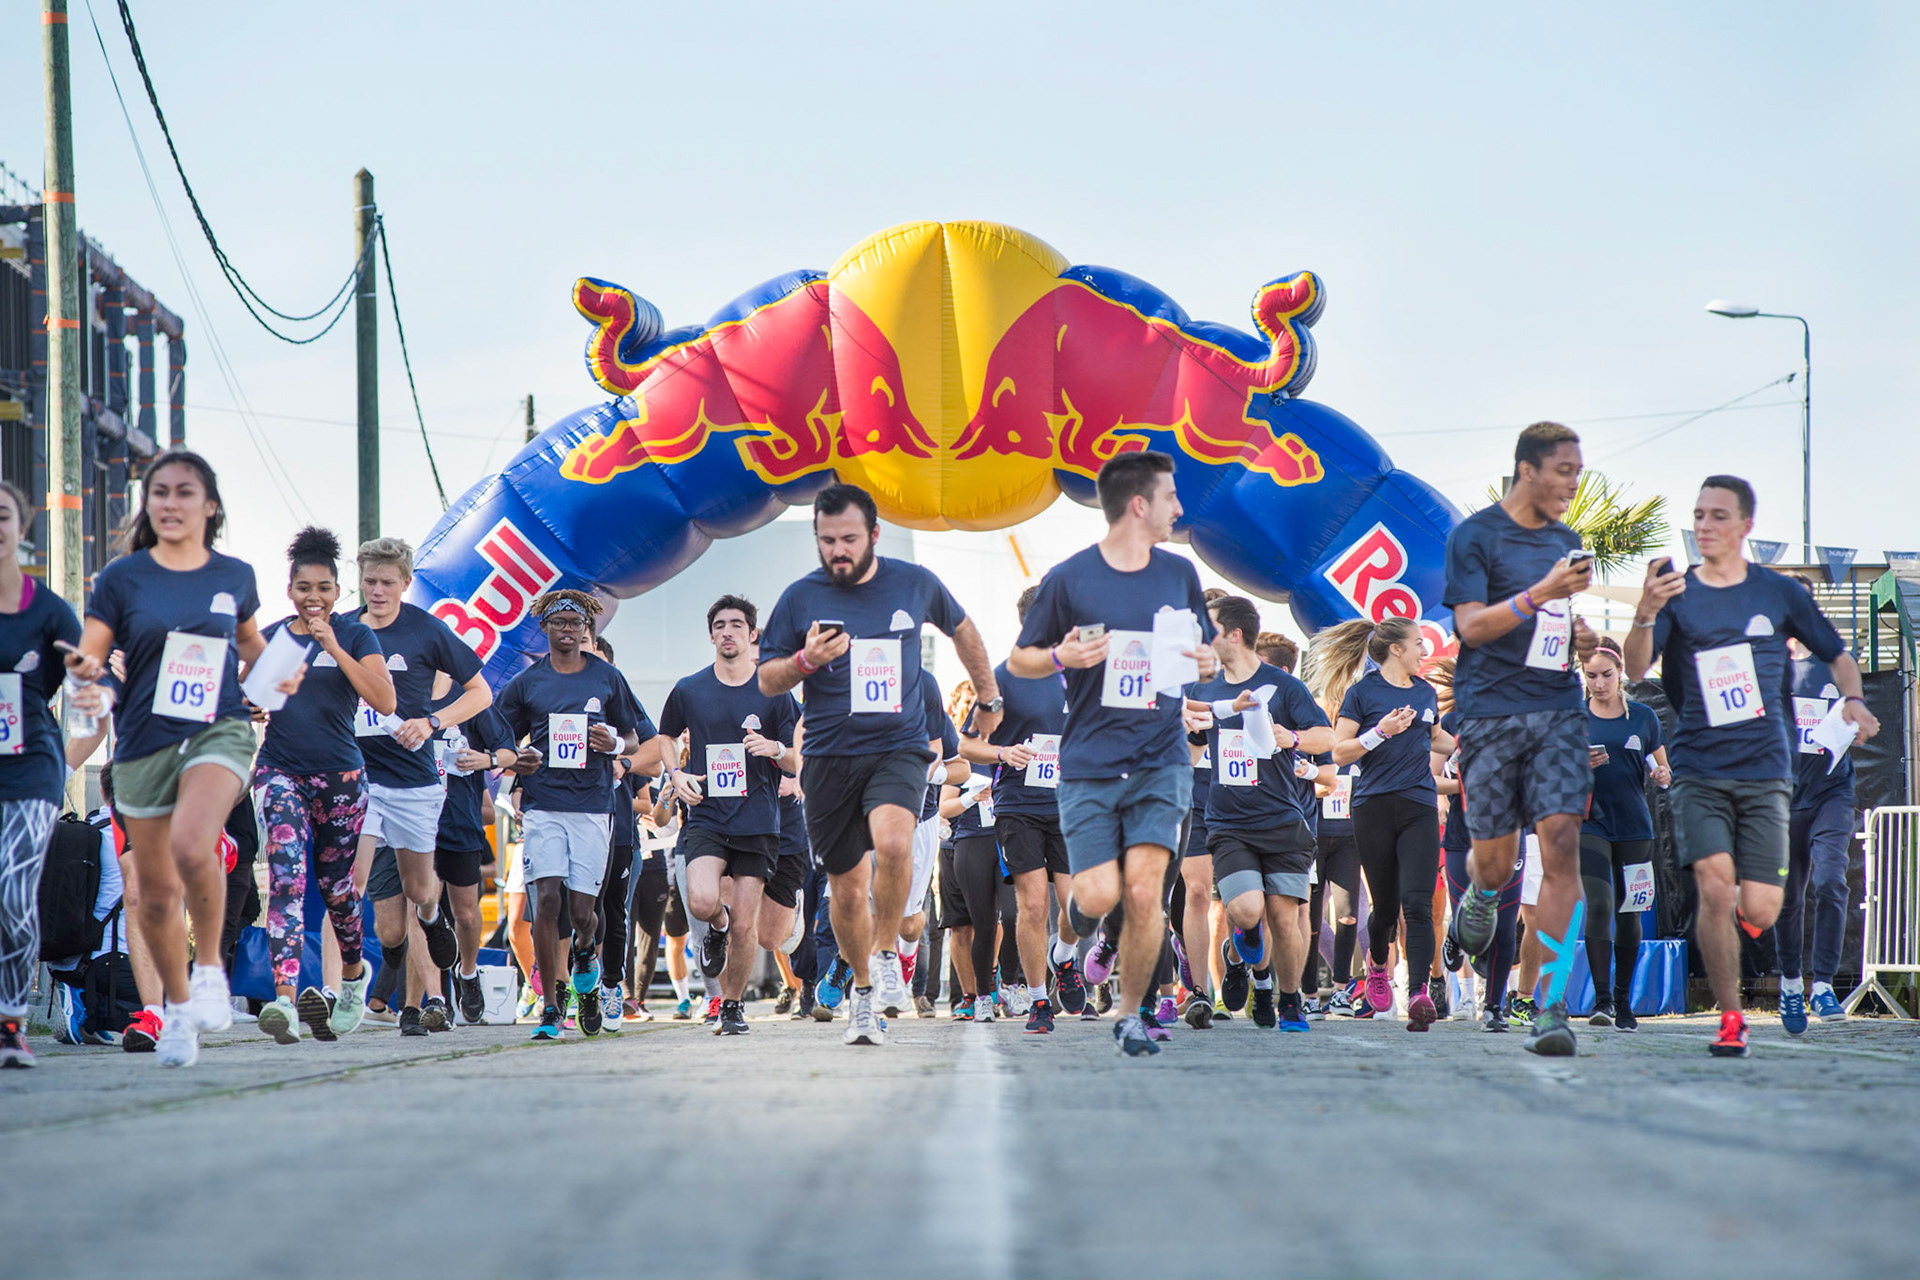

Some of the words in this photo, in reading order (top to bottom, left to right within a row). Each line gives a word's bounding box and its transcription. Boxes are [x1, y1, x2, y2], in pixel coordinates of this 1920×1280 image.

[430, 520, 559, 663] Bull
[167, 661, 214, 679] ÉQUIPE
[857, 664, 896, 677] ÉQUIPE
[1708, 671, 1751, 689] ÉQUIPE
[553, 731, 583, 742] ÉQUIPE
[711, 761, 742, 771] ÉQUIPE
[1037, 763, 1054, 779] 16
[1630, 881, 1653, 892] ÉQUIPE
[1632, 891, 1647, 906] 16
